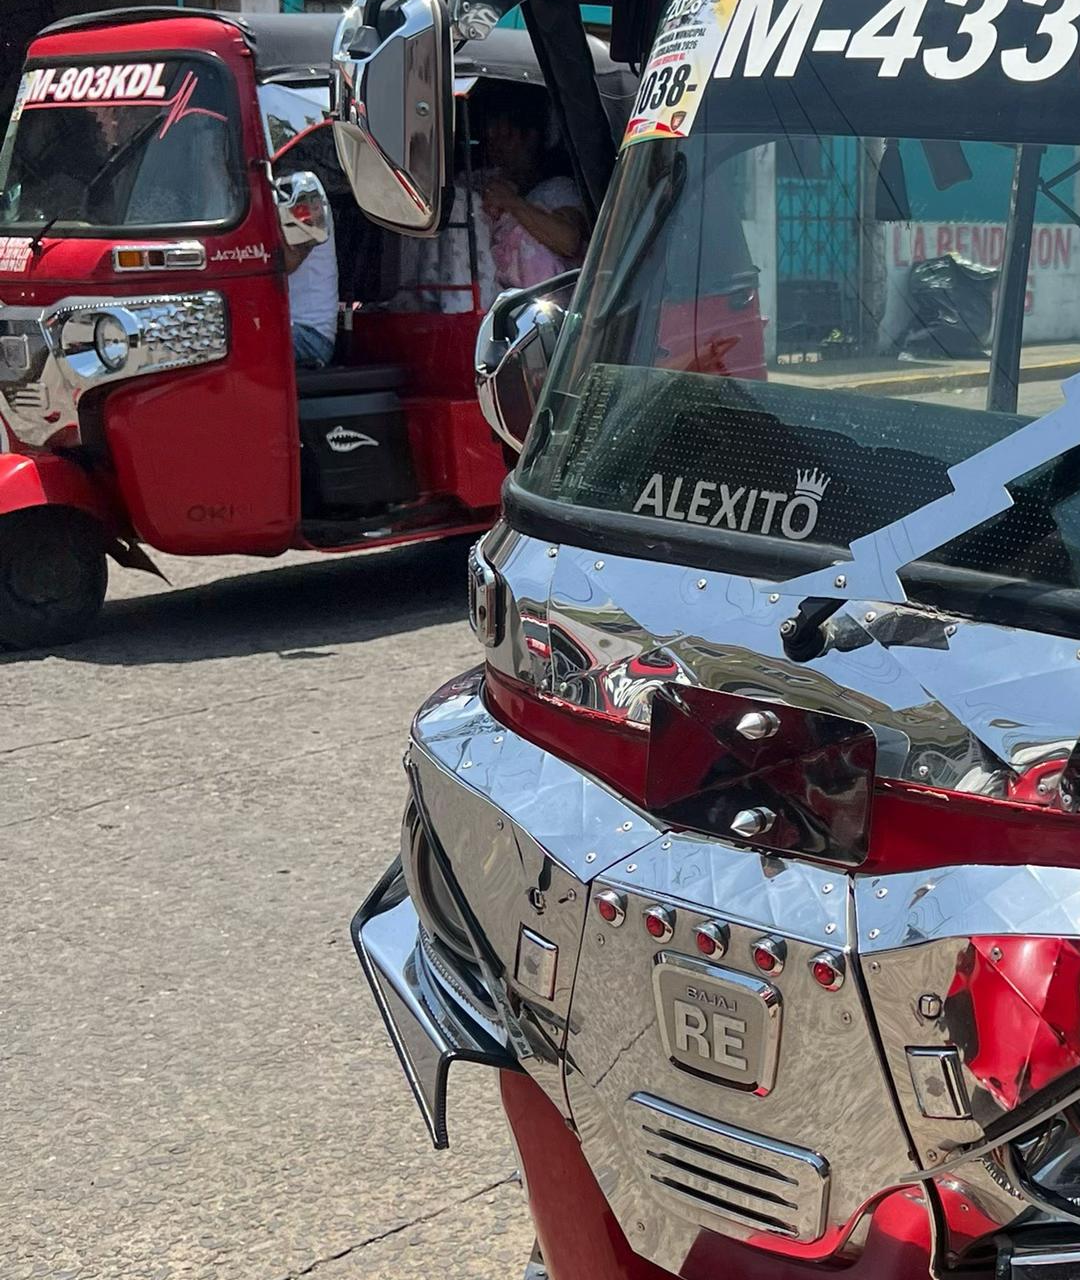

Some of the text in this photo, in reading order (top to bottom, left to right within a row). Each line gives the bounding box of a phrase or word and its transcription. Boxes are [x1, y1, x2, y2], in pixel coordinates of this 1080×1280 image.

[25, 63, 166, 102] M-803KDL
[892, 226, 1073, 270] LA BENDION
[632, 473, 819, 540] ALEXITO
[686, 986, 738, 1012] BAJAJ
[674, 998, 748, 1071] RE
